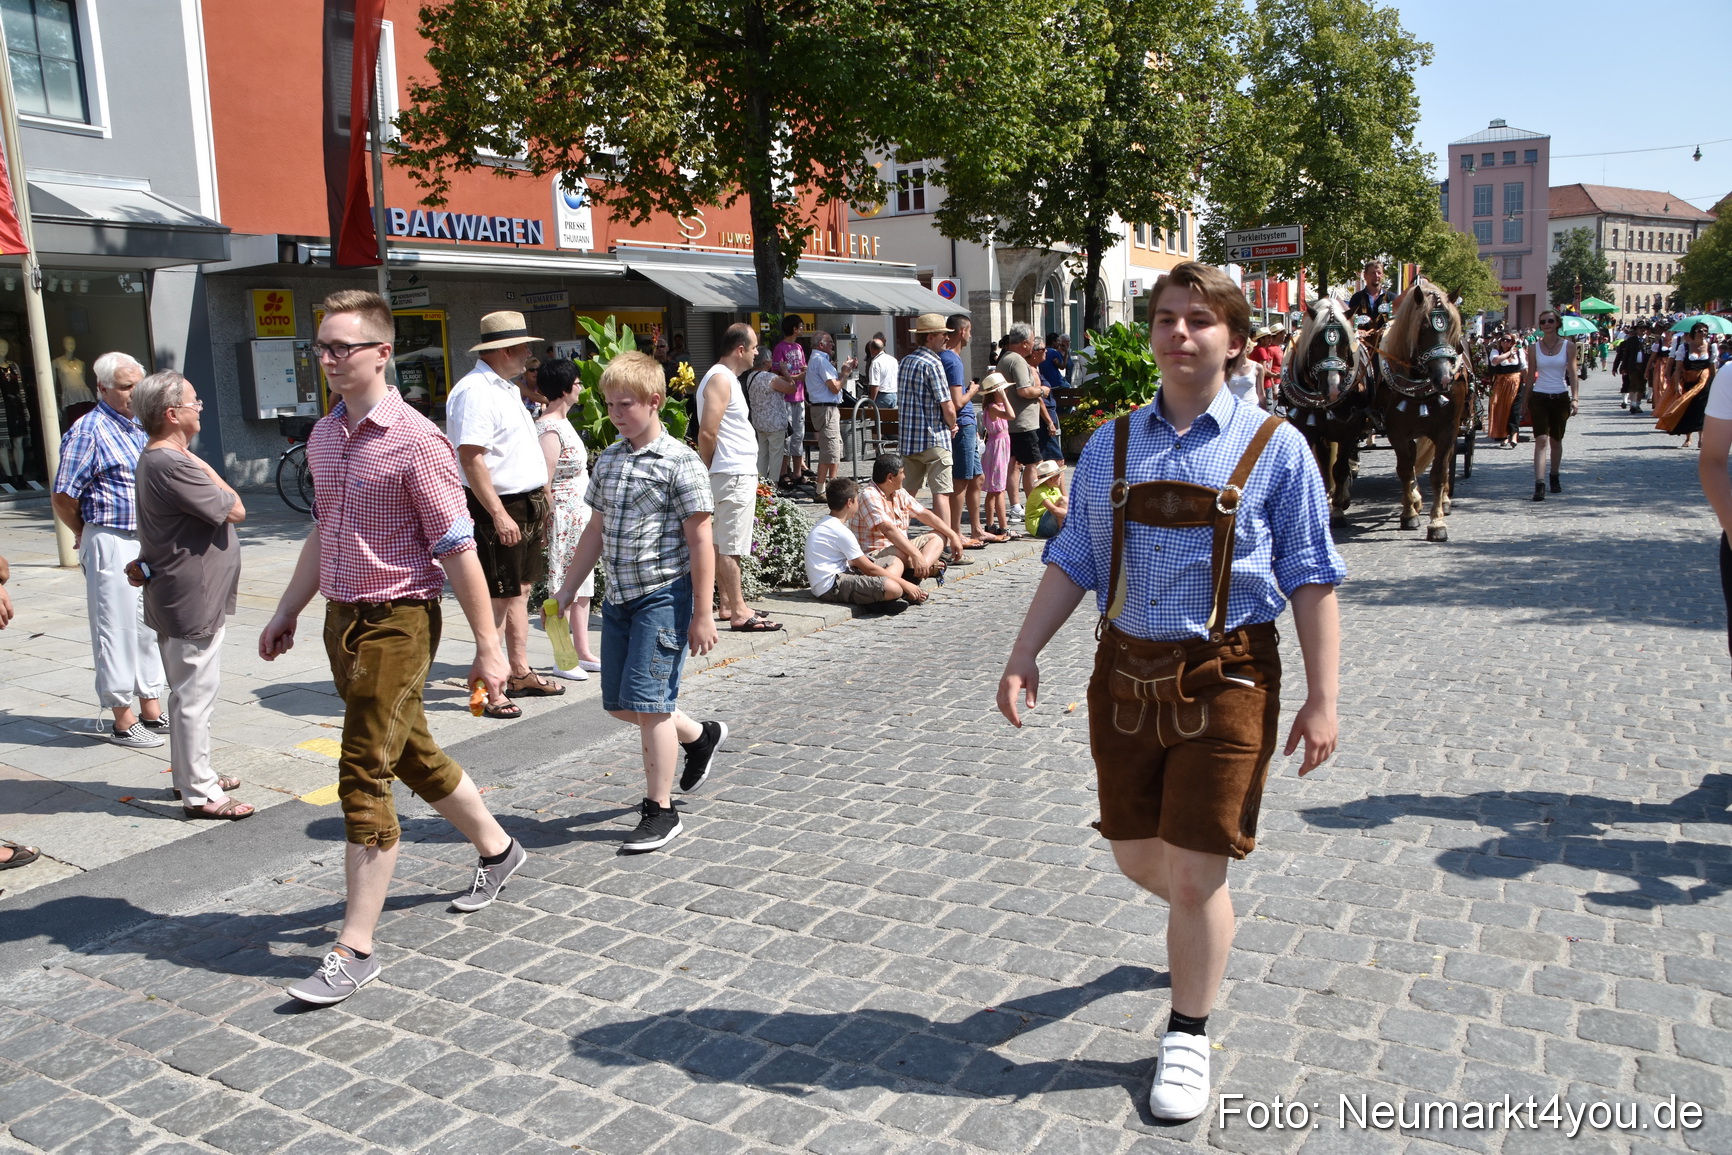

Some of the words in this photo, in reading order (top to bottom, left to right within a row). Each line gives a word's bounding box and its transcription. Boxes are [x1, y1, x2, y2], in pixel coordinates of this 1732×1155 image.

[376, 207, 545, 245] BAKWAREN
[564, 220, 587, 231] PRESSE
[563, 233, 590, 244] THUMANN
[721, 231, 751, 246] juwe
[783, 225, 881, 256] HLIERF
[1237, 231, 1287, 242] Parkleitsystem
[1255, 246, 1288, 255] Rosengasse
[259, 315, 291, 326] LOTTO
